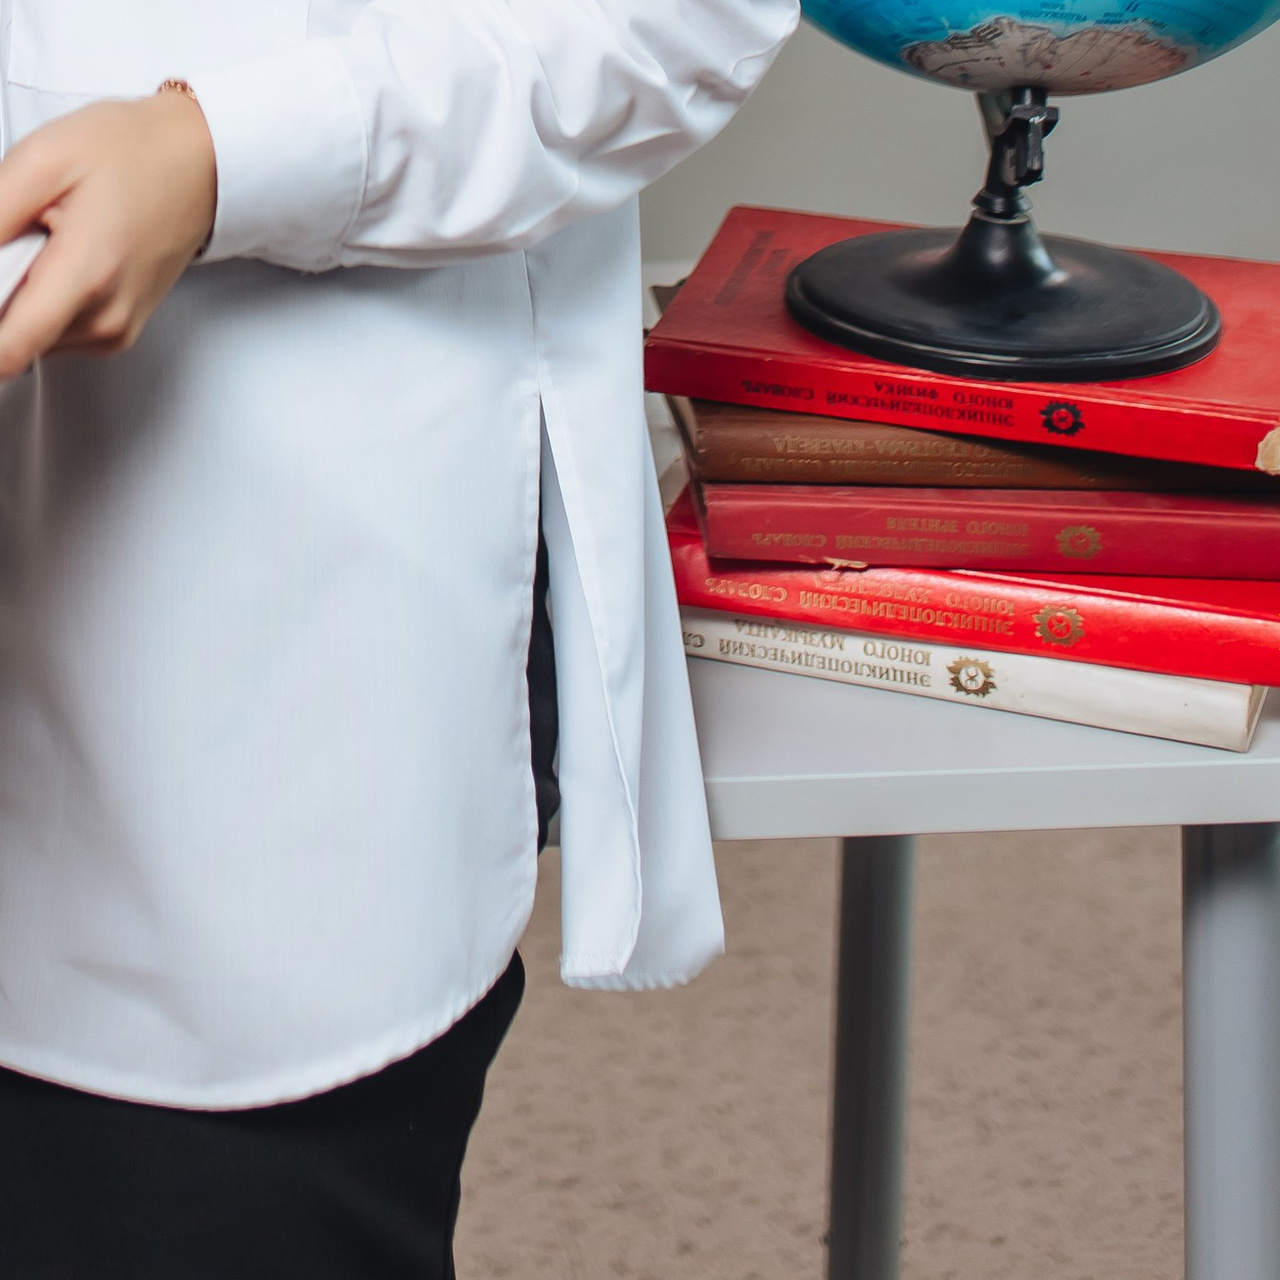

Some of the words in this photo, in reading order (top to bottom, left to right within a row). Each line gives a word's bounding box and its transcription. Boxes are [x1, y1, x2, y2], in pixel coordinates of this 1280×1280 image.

[741, 379, 815, 402] СЛОВАРЬ
[873, 380, 939, 402] ФИЗИКА
[952, 390, 1015, 411] ЮНОГО
[826, 390, 1015, 429] ЭНЦИКЛОПЕДИЧЕСКИЙ
[886, 517, 959, 533] ЗРИТЕЛЯ
[967, 520, 1030, 536] ЮНОГО
[751, 533, 827, 548] СЛОВАРЬ
[835, 534, 1030, 557] ЭНЦИКЛОПЕДИЧЕСКИЙ
[799, 591, 1015, 635] ЭНЦИКЛОПЕДИЧЕСКИЙ
[945, 592, 1016, 616] ЮНОГО
[733, 618, 846, 651] МУЗЫКАНТА
[718, 638, 932, 688] ЭНЦИКЛОПЕДИЧЕСКИЙ
[862, 640, 933, 667] ЮНОГО
